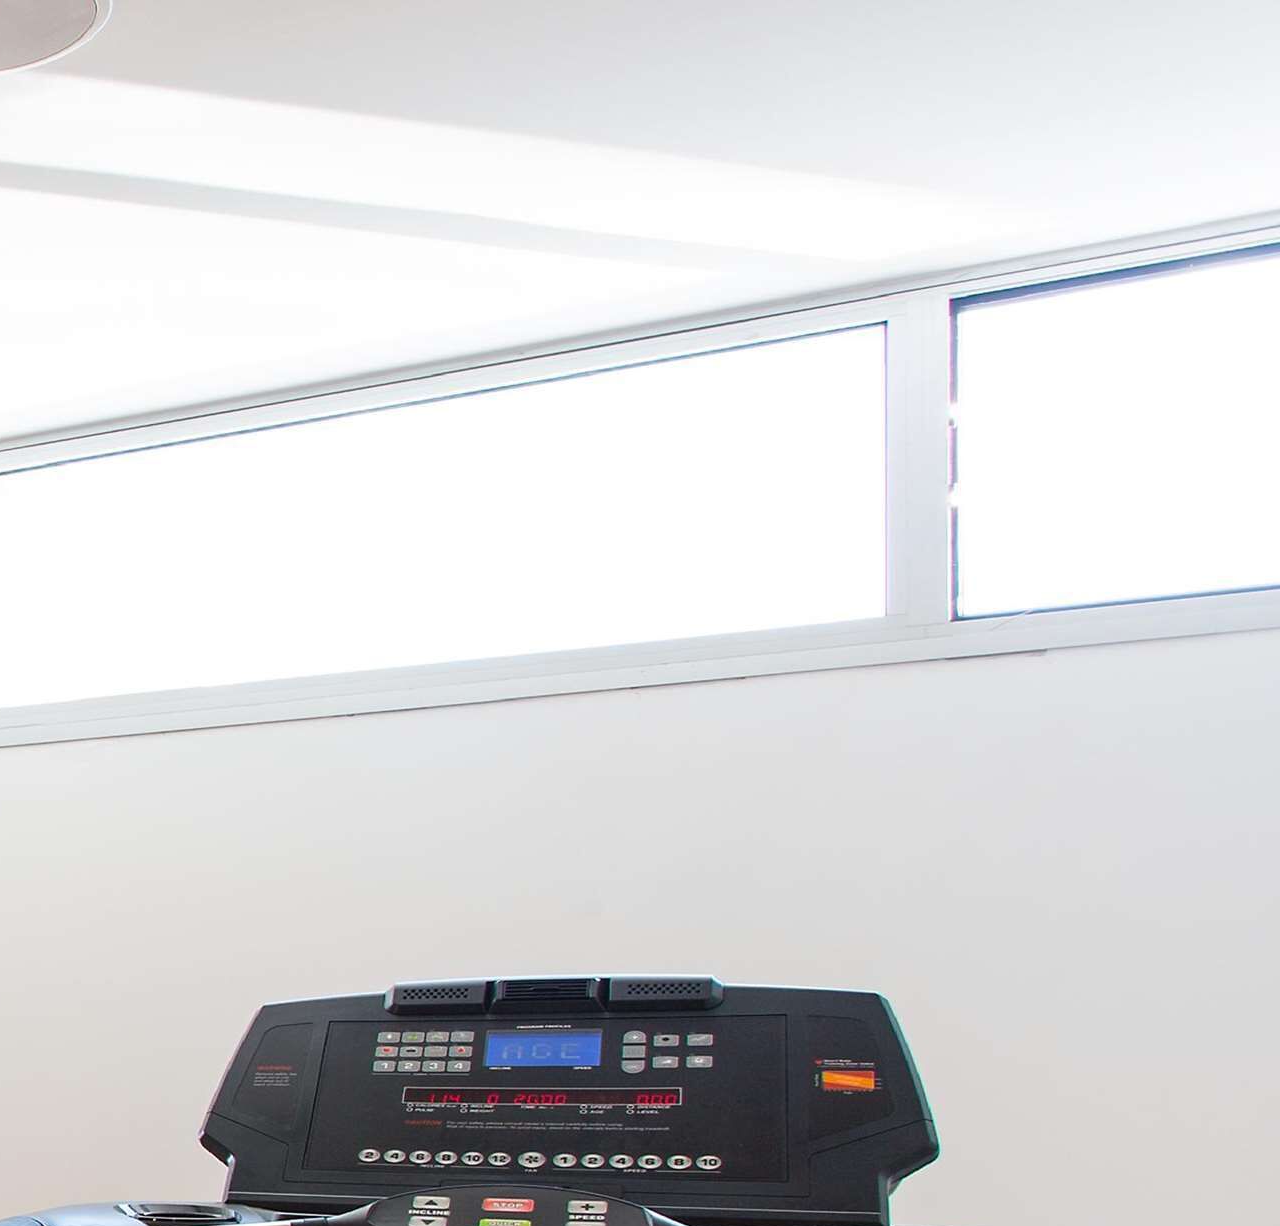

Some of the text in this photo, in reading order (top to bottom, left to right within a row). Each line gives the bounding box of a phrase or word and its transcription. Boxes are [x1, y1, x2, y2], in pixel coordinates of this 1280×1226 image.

[381, 1062, 464, 1070] 1 2 3 4
[364, 1151, 374, 1159] 2
[390, 1152, 399, 1160] 4
[416, 1153, 425, 1161] 6
[492, 1155, 508, 1163] 12
[587, 1157, 598, 1165] 2
[615, 1157, 627, 1165] 4
[645, 1158, 655, 1166] 6
[673, 1158, 685, 1166] 8
[700, 1158, 717, 1166] 10
